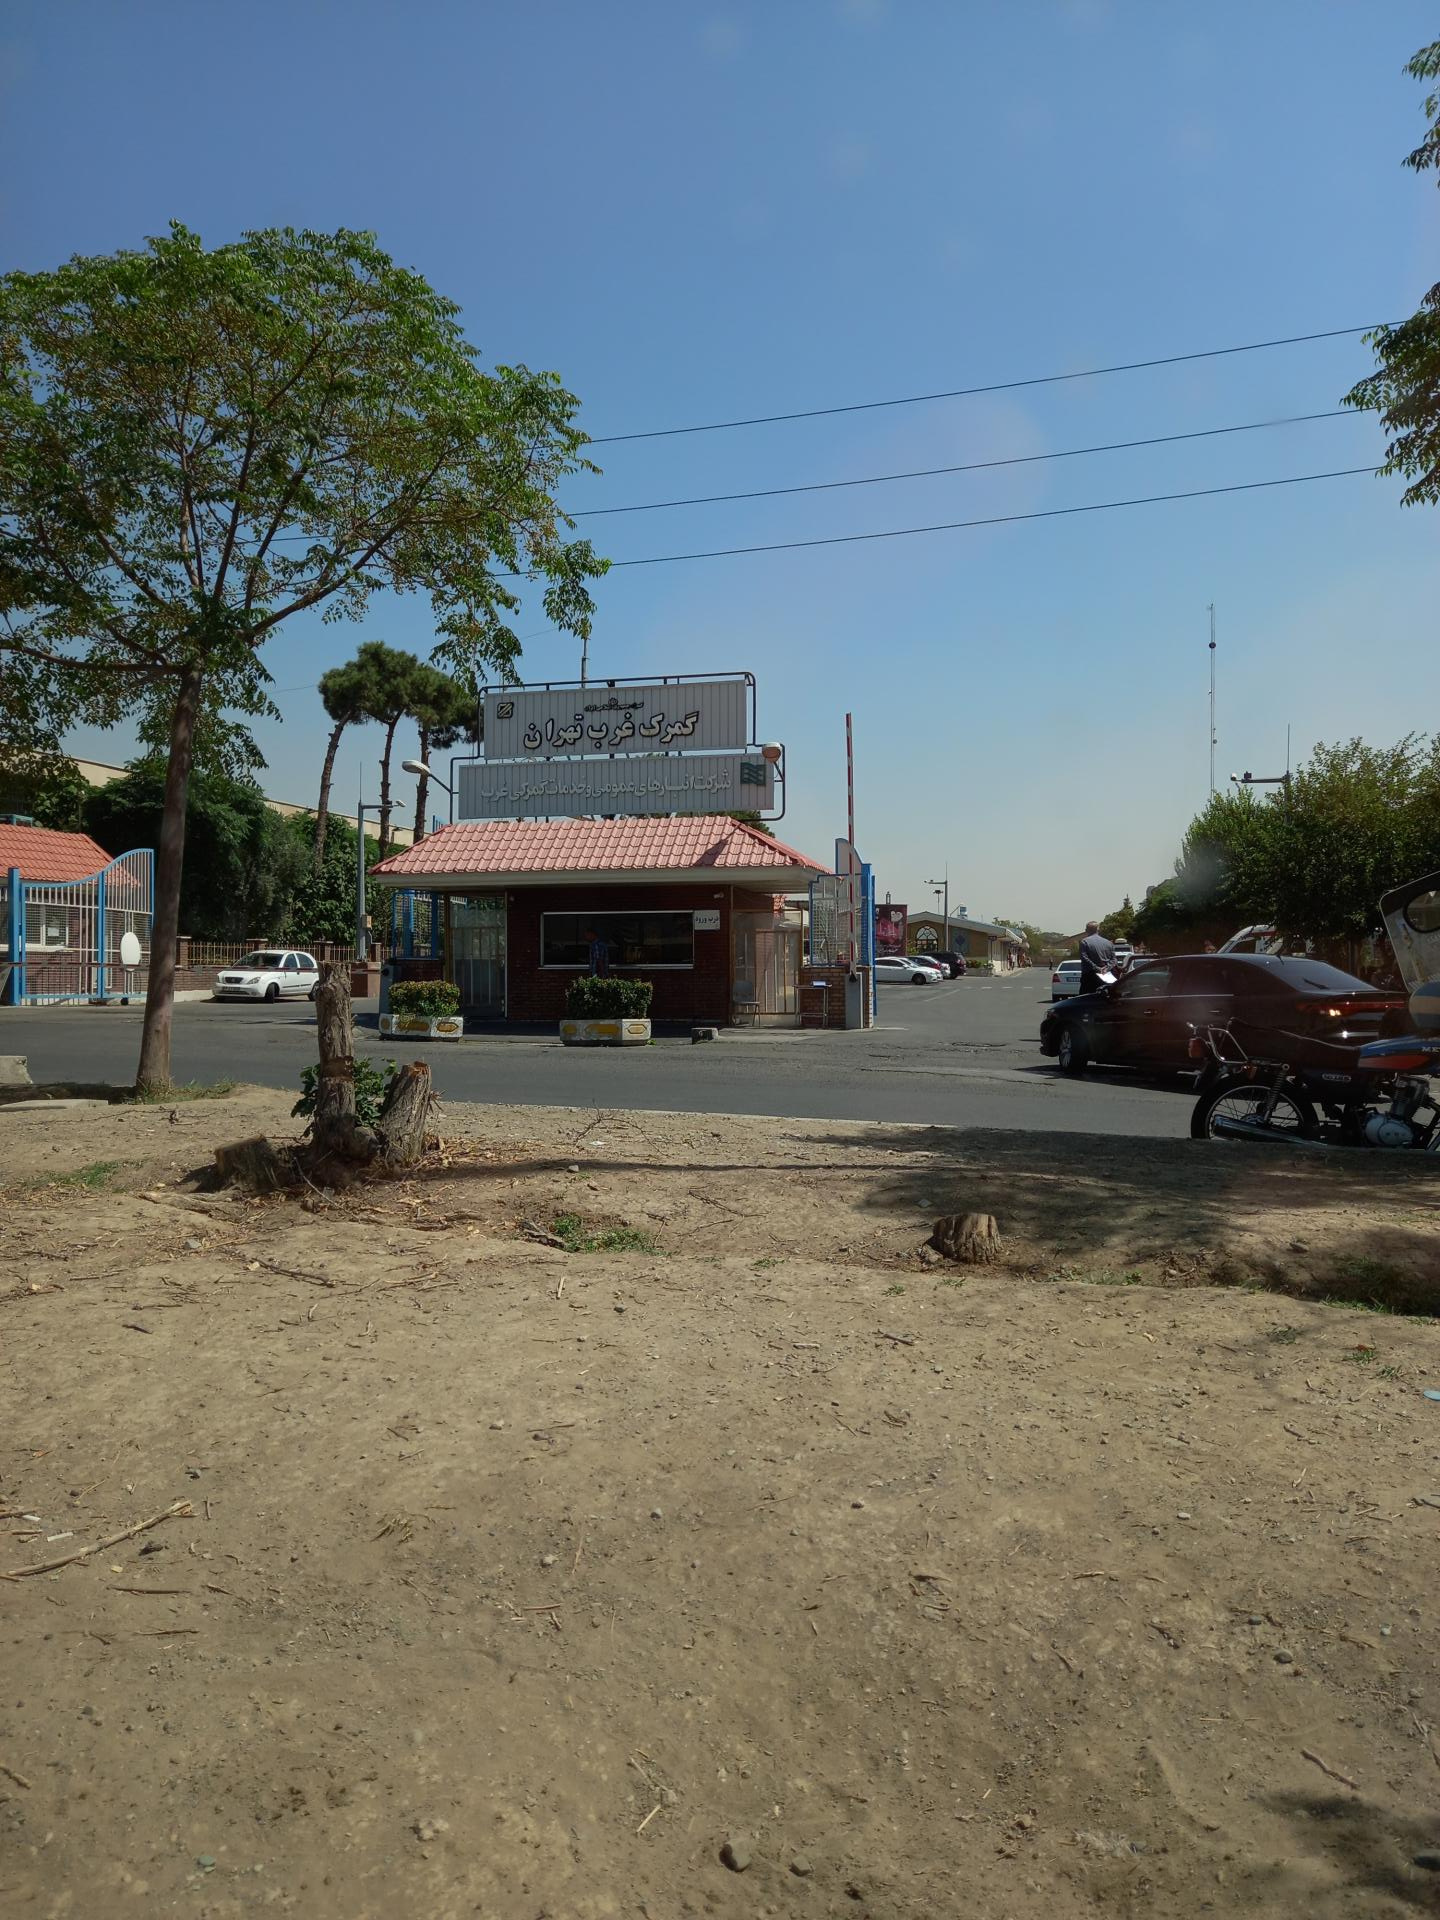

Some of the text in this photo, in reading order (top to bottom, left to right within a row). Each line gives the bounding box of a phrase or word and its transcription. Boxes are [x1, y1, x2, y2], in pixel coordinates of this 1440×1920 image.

[523, 711, 699, 749] گمرک غرب تهران
[481, 780, 509, 802] غرب
[591, 779, 635, 799] عمومی
[634, 774, 694, 799] انبارهای
[693, 768, 732, 794] شرکت
[695, 916, 707, 924] ورود
